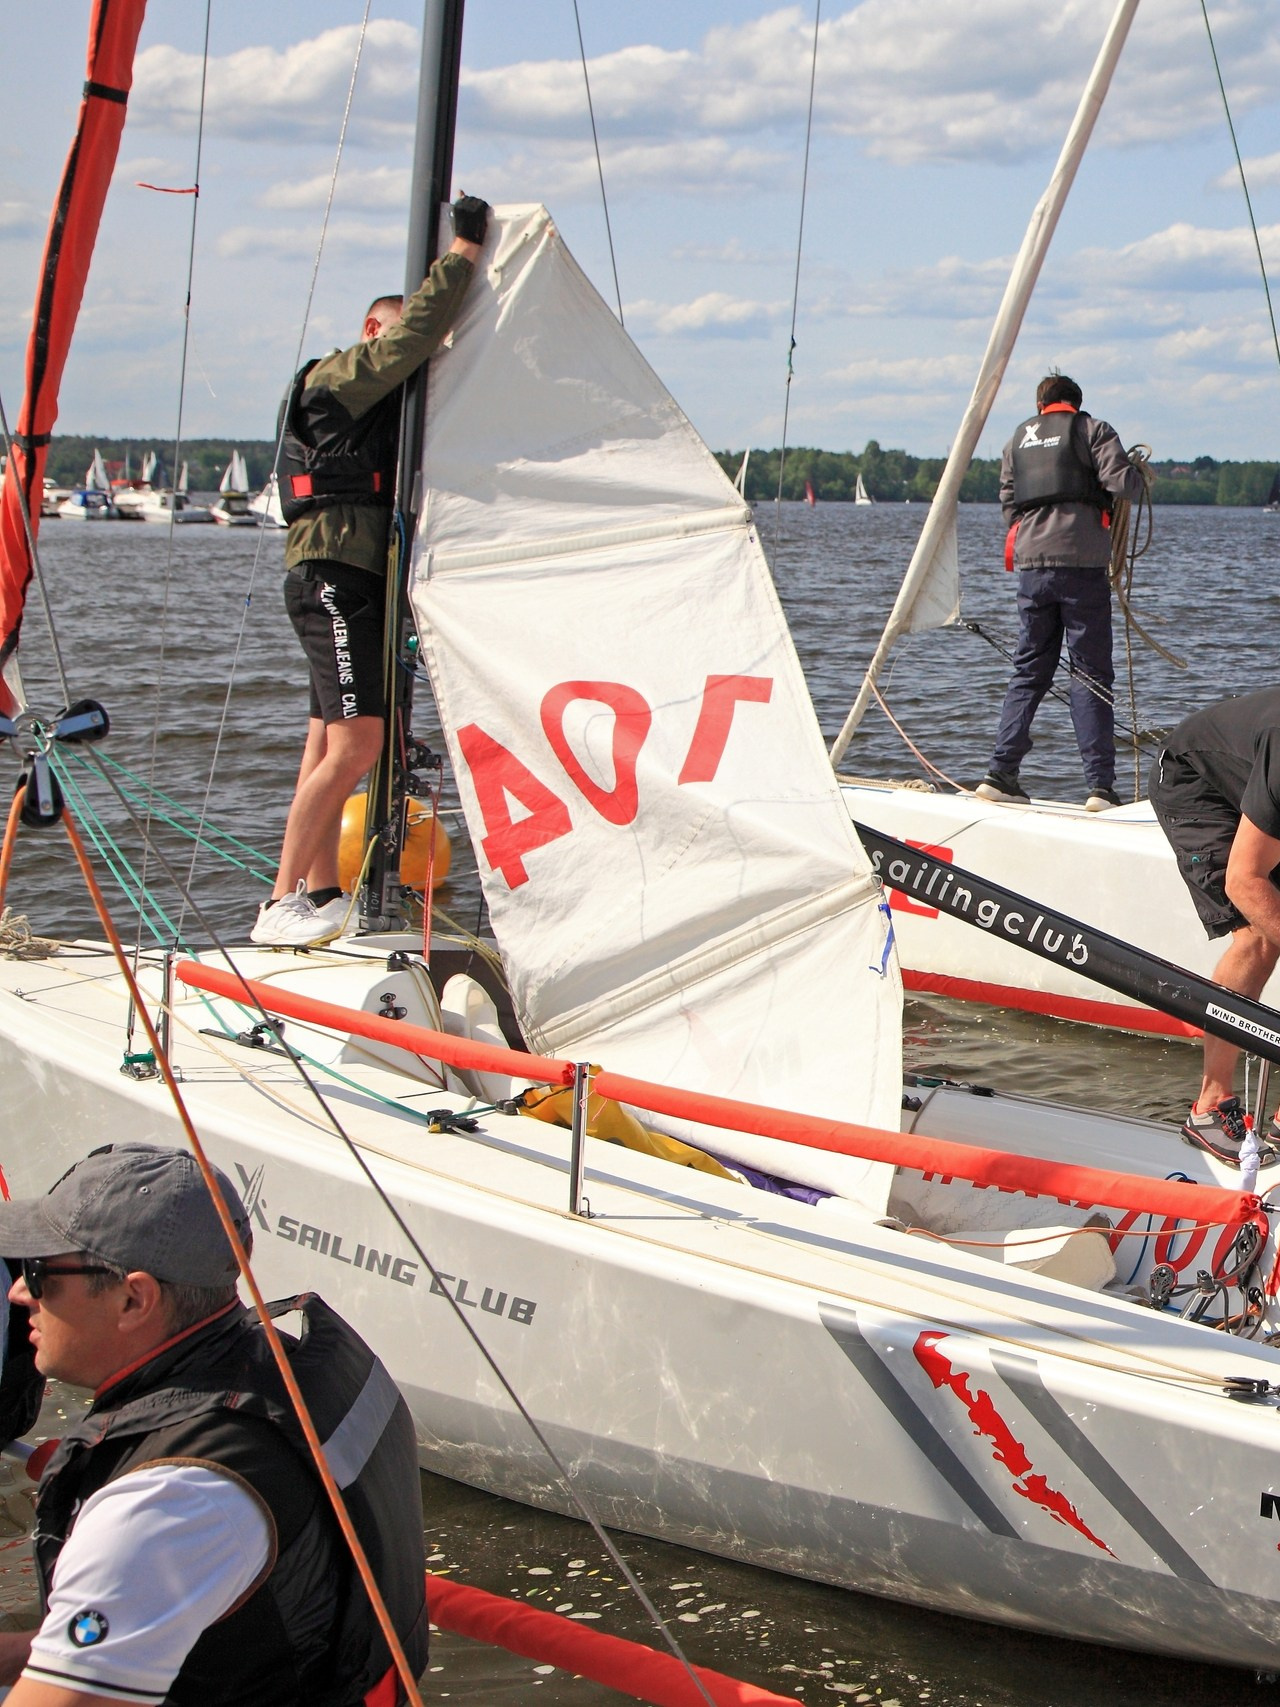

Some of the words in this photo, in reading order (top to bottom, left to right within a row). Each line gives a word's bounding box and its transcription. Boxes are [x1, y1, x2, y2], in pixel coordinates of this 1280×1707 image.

[332, 612, 348, 648] KLEIN
[336, 648, 353, 685] JEANS
[1211, 1007, 1236, 1023] WIND
[276, 1215, 419, 1286] SAILING
[429, 1271, 538, 1326] CLUB
